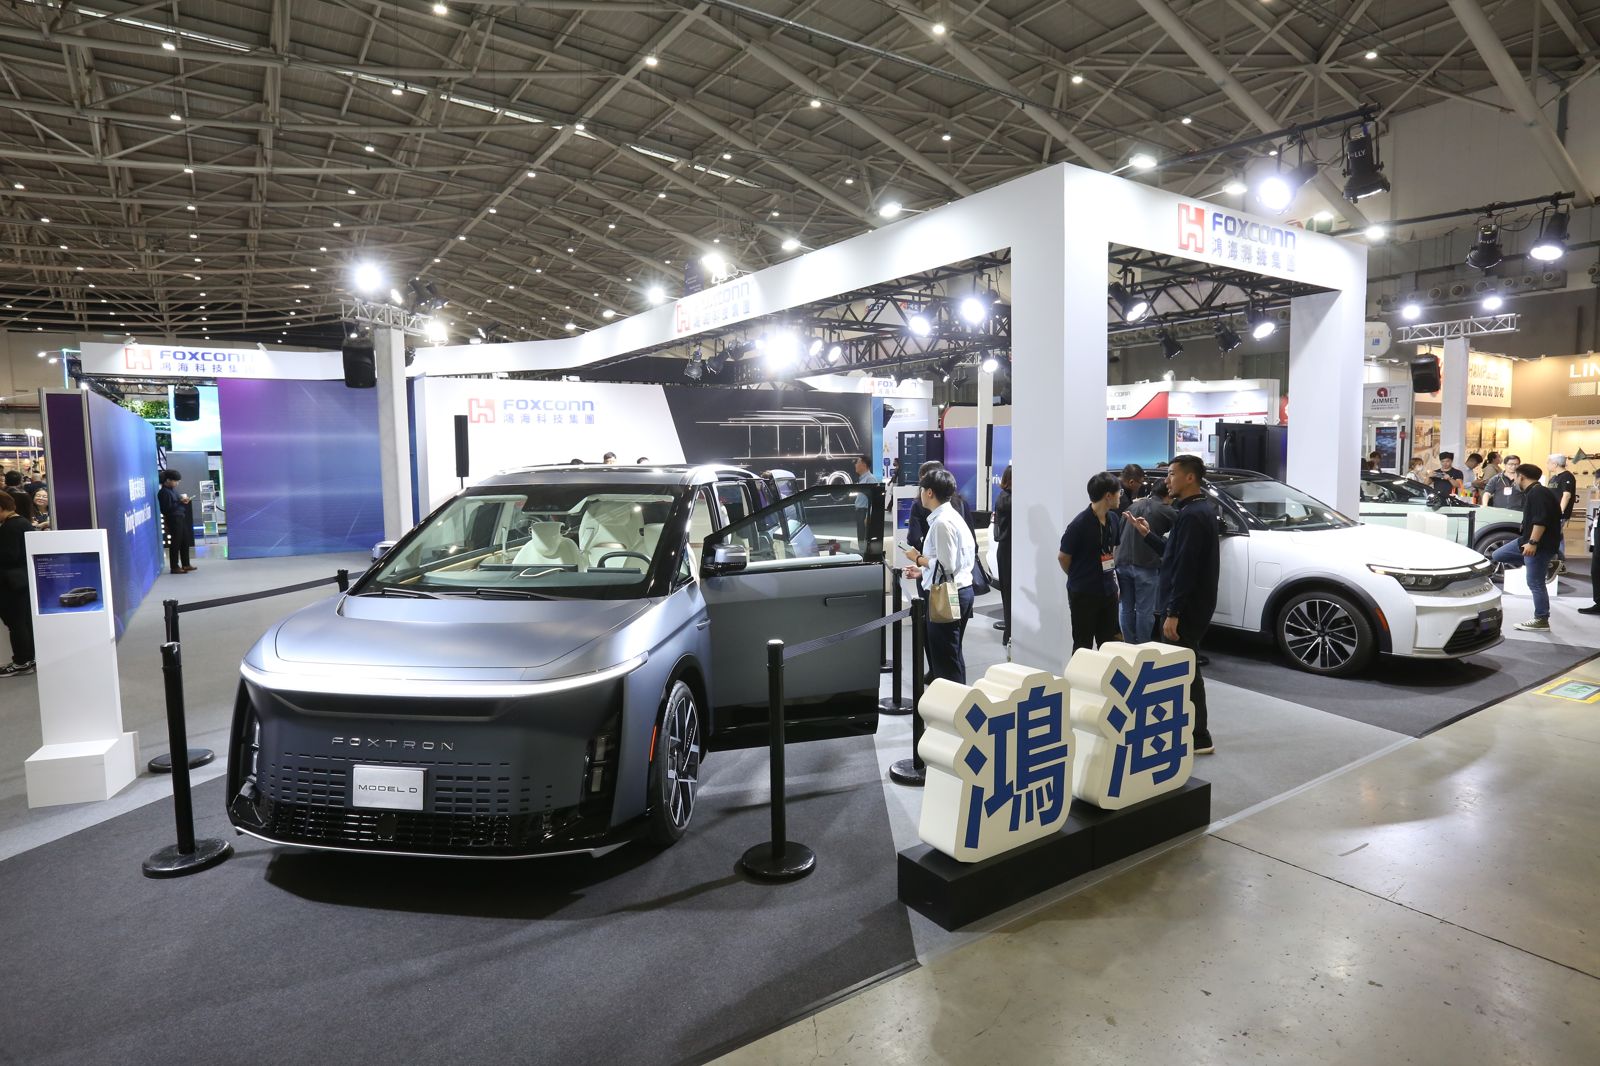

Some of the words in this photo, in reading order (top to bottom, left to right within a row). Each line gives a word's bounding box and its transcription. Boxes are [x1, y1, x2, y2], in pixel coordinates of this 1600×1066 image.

[1212, 212, 1296, 250] FOXCONN
[160, 350, 254, 363] FOXCON
[503, 399, 594, 411] FOXCONN
[503, 413, 594, 424] 鴻海科技集團
[331, 736, 454, 751] FOXTRON
[964, 661, 1190, 849] 鴻海
[358, 784, 405, 793] MODEL
